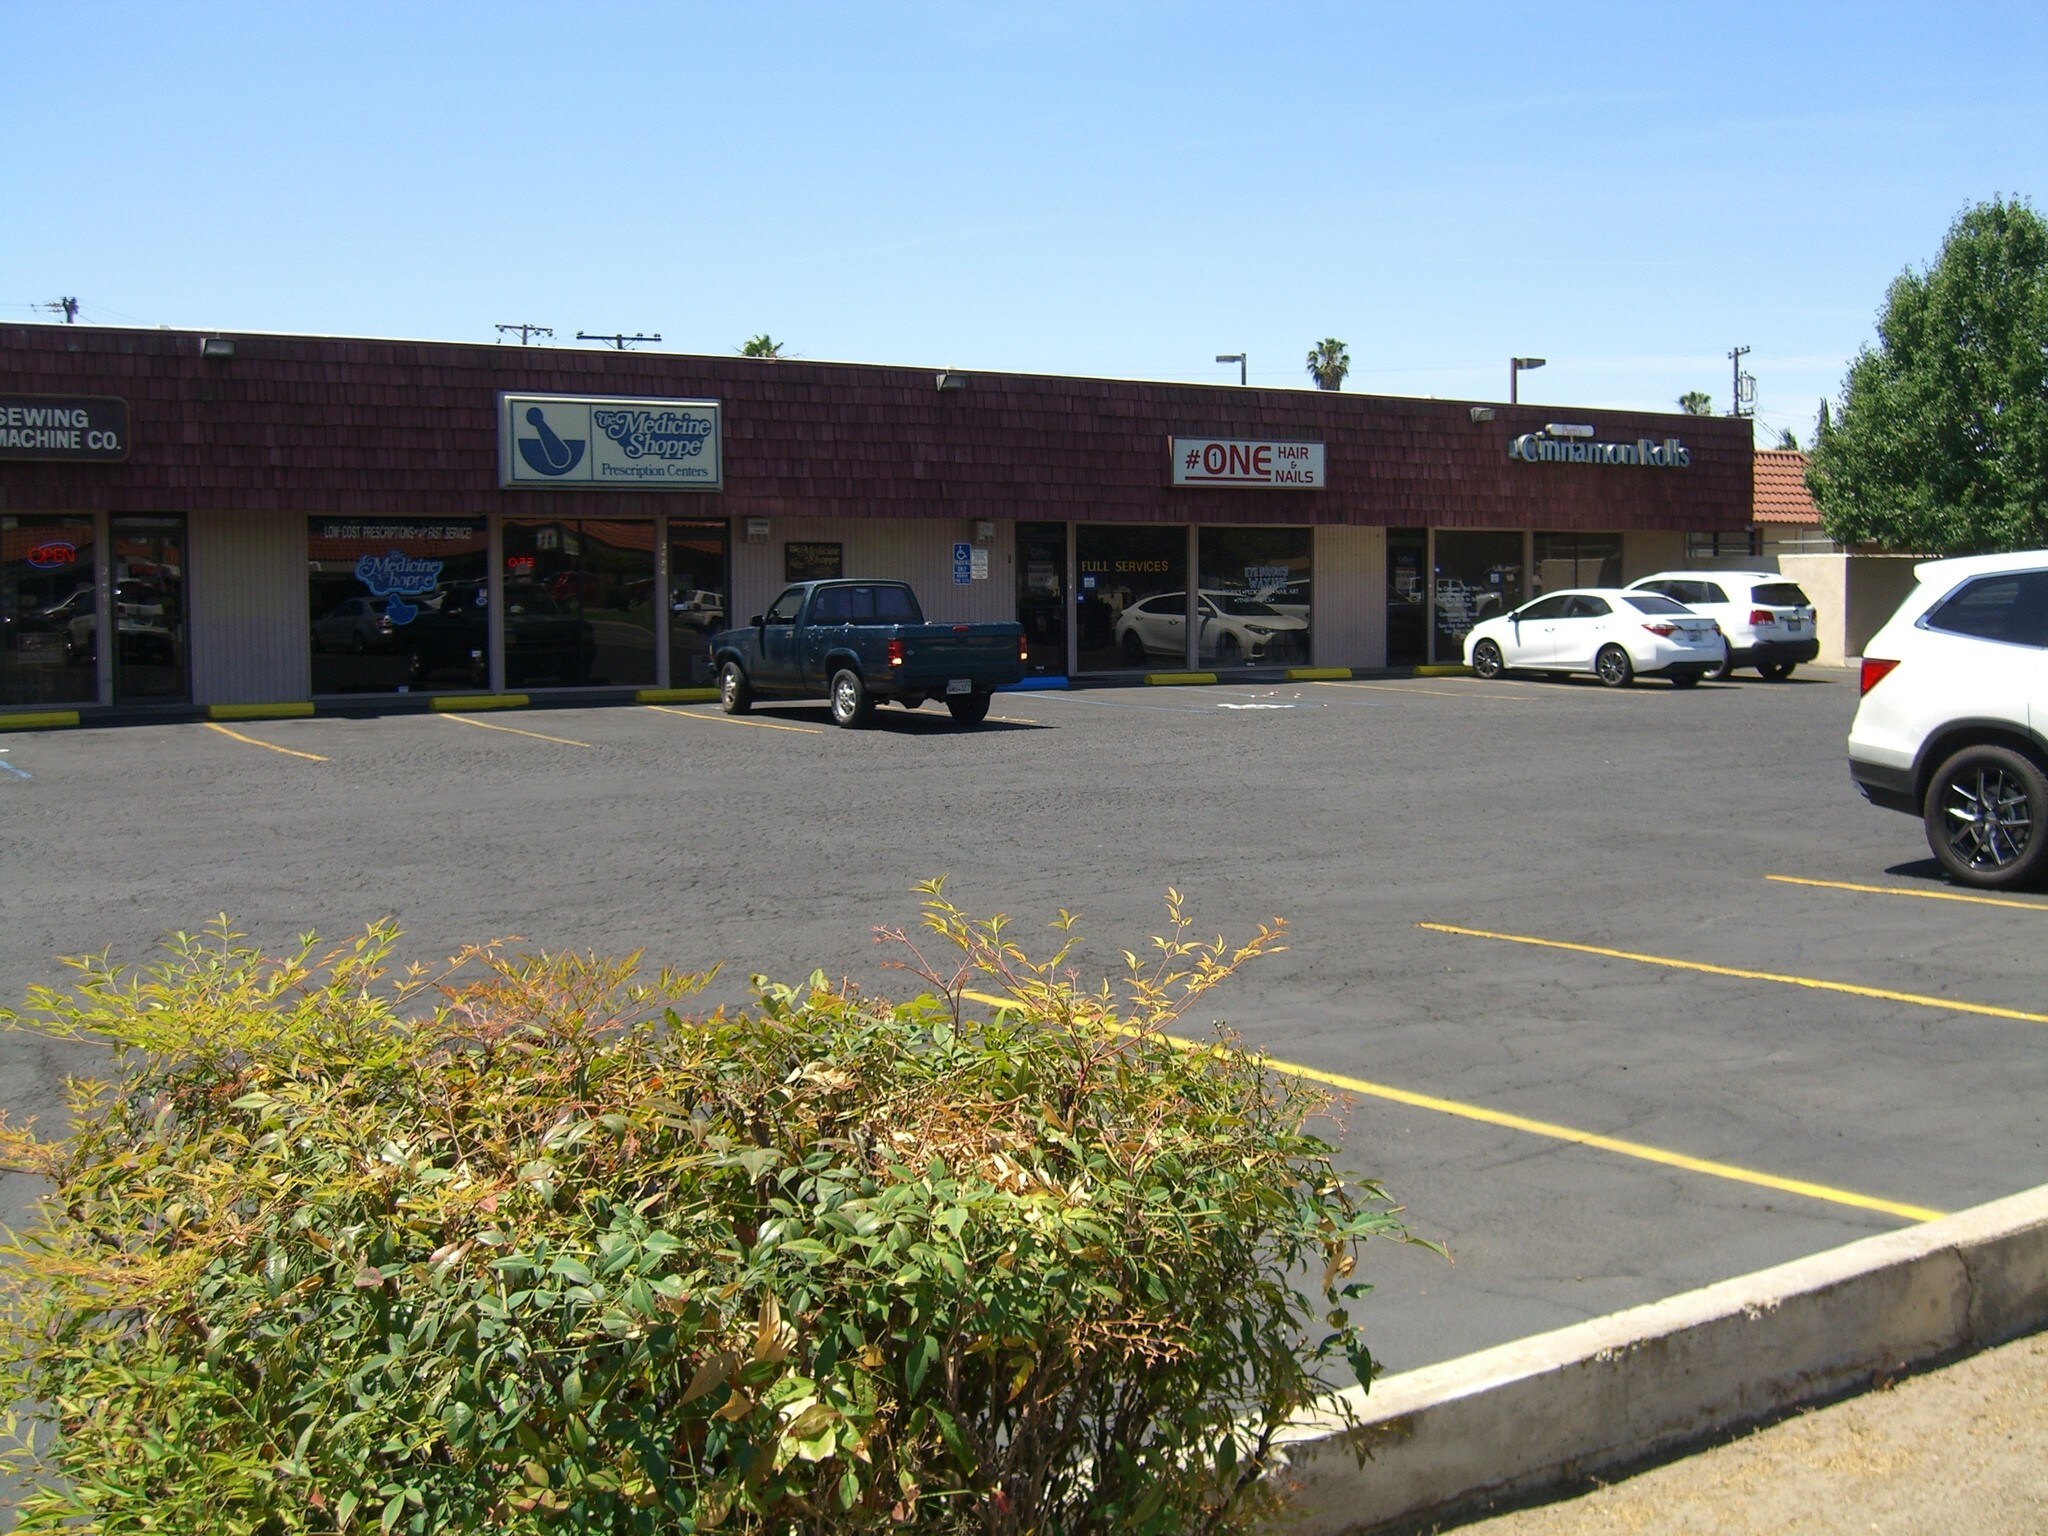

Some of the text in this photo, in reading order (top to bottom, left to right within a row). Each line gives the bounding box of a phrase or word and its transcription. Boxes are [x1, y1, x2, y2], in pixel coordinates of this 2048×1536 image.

[0, 407, 89, 428] SEWING
[607, 411, 712, 439] Medicine
[87, 430, 122, 451] CO.
[625, 433, 702, 459] Shoppe
[1517, 430, 1691, 468] Cinnamon Rolls
[1278, 446, 1309, 460] HAIR
[601, 463, 709, 479] Prescription Centers
[1290, 460, 1297, 469] &
[1275, 470, 1314, 484] NAILS
[324, 525, 340, 539] LOW
[342, 526, 361, 539] COST
[27, 546, 78, 563] OPEN
[359, 557, 439, 576] Medicine
[1081, 560, 1169, 572] FULL SERVICES
